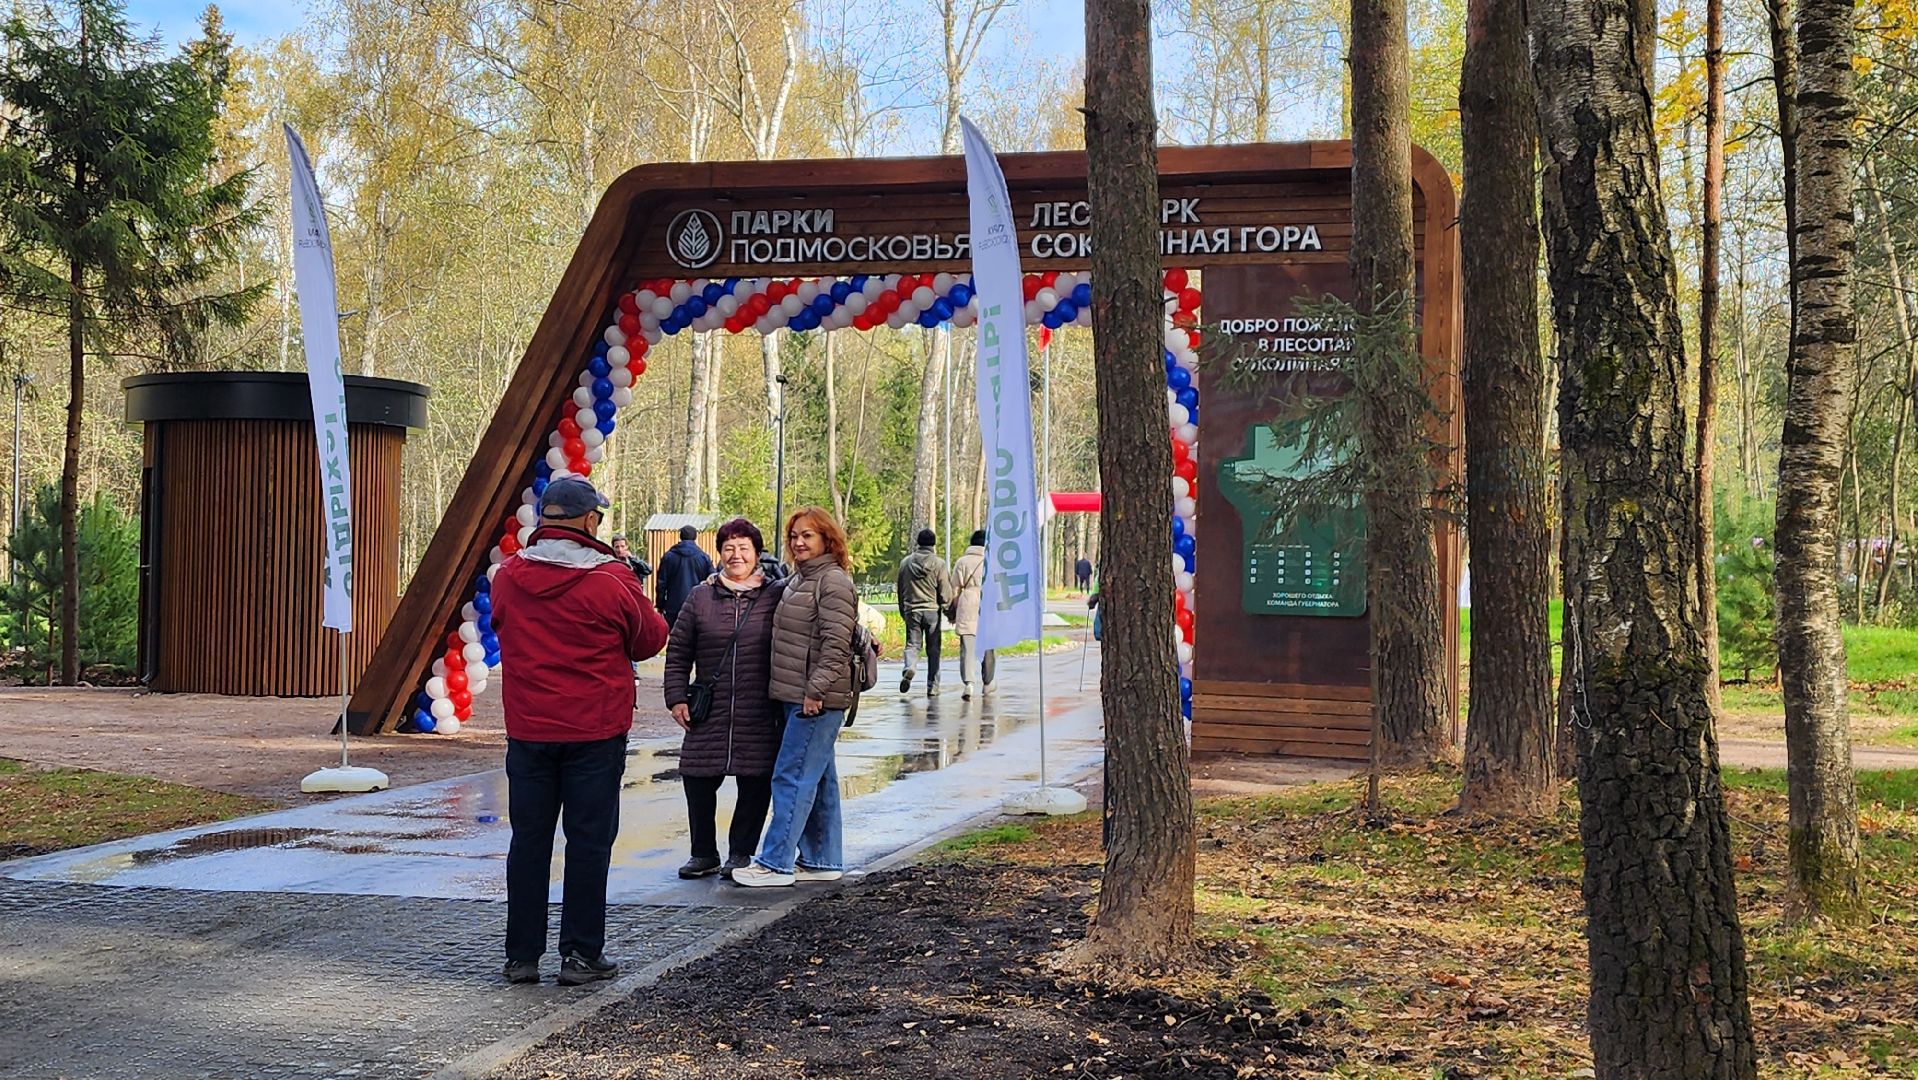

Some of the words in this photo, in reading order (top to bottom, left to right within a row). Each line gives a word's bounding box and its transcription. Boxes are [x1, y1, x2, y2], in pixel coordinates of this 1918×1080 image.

[730, 208, 834, 235] ПАРКИ
[1030, 198, 1201, 227] ЛЕСРК
[730, 234, 973, 264] ПОДМОСКОВЬЯ
[1031, 228, 1230, 258] СОКНАЯ
[1240, 225, 1322, 252] ГОРА
[1218, 319, 1279, 335] ДОБРО
[1259, 338, 1269, 352] В
